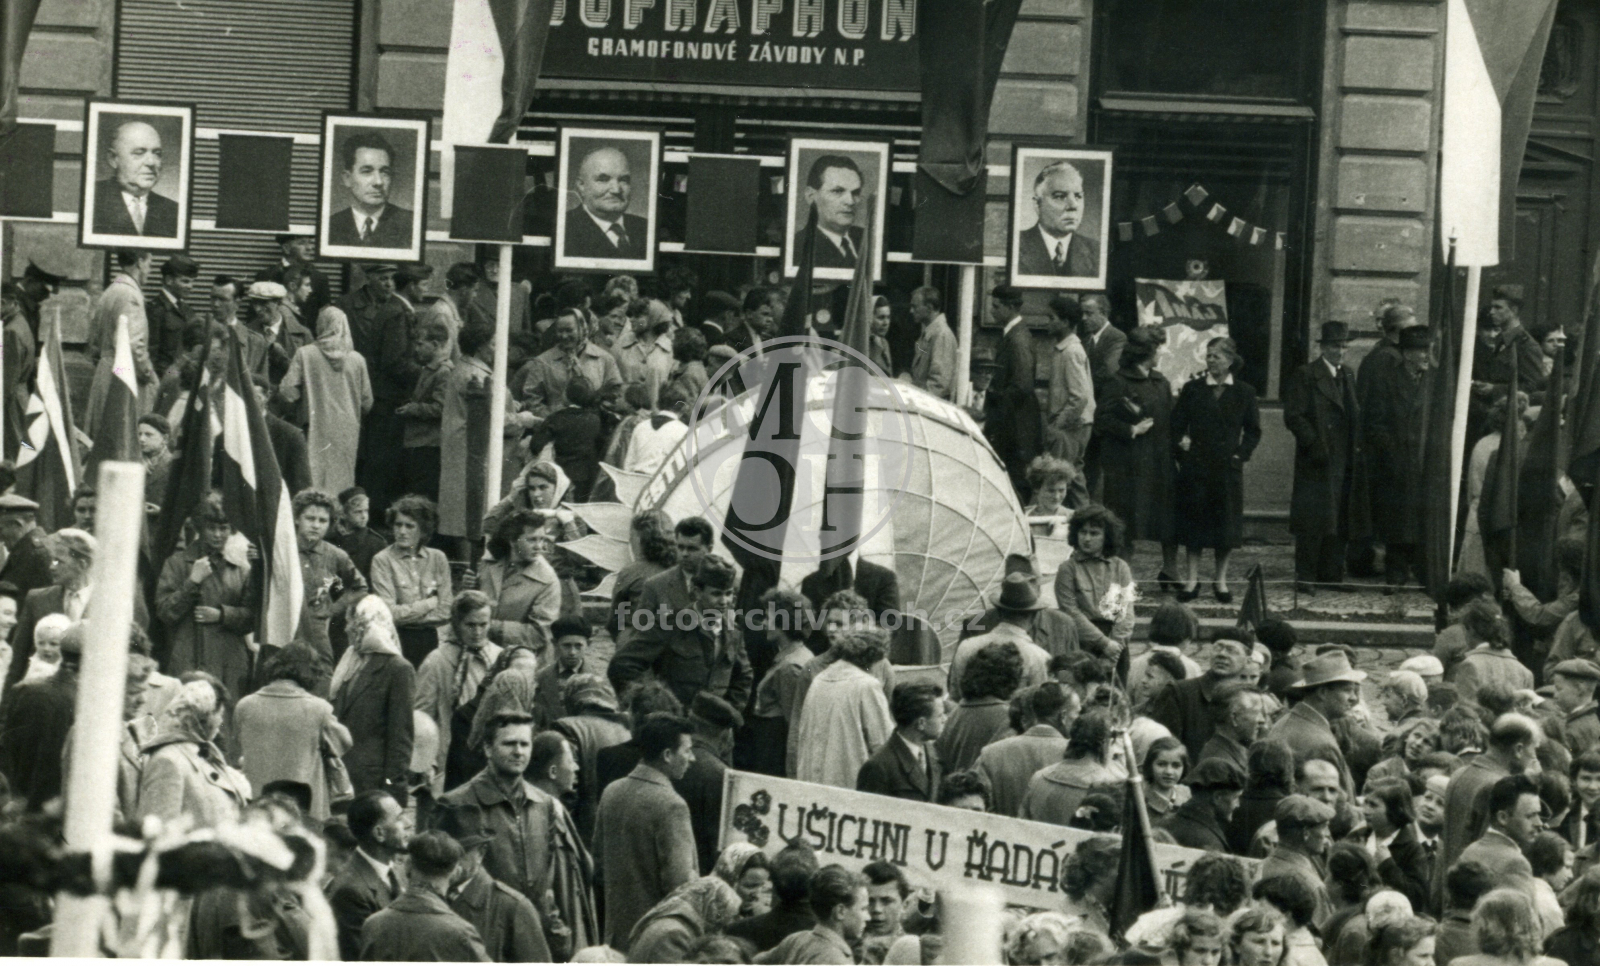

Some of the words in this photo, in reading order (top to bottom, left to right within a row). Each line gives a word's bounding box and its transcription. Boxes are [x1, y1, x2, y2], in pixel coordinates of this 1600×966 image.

[549, 0, 917, 41] UPRAPHON
[588, 37, 737, 61] GRAMOFONOVÉ
[748, 41, 826, 65] ZÁVODY
[964, 829, 1070, 893] ŘADÁ
